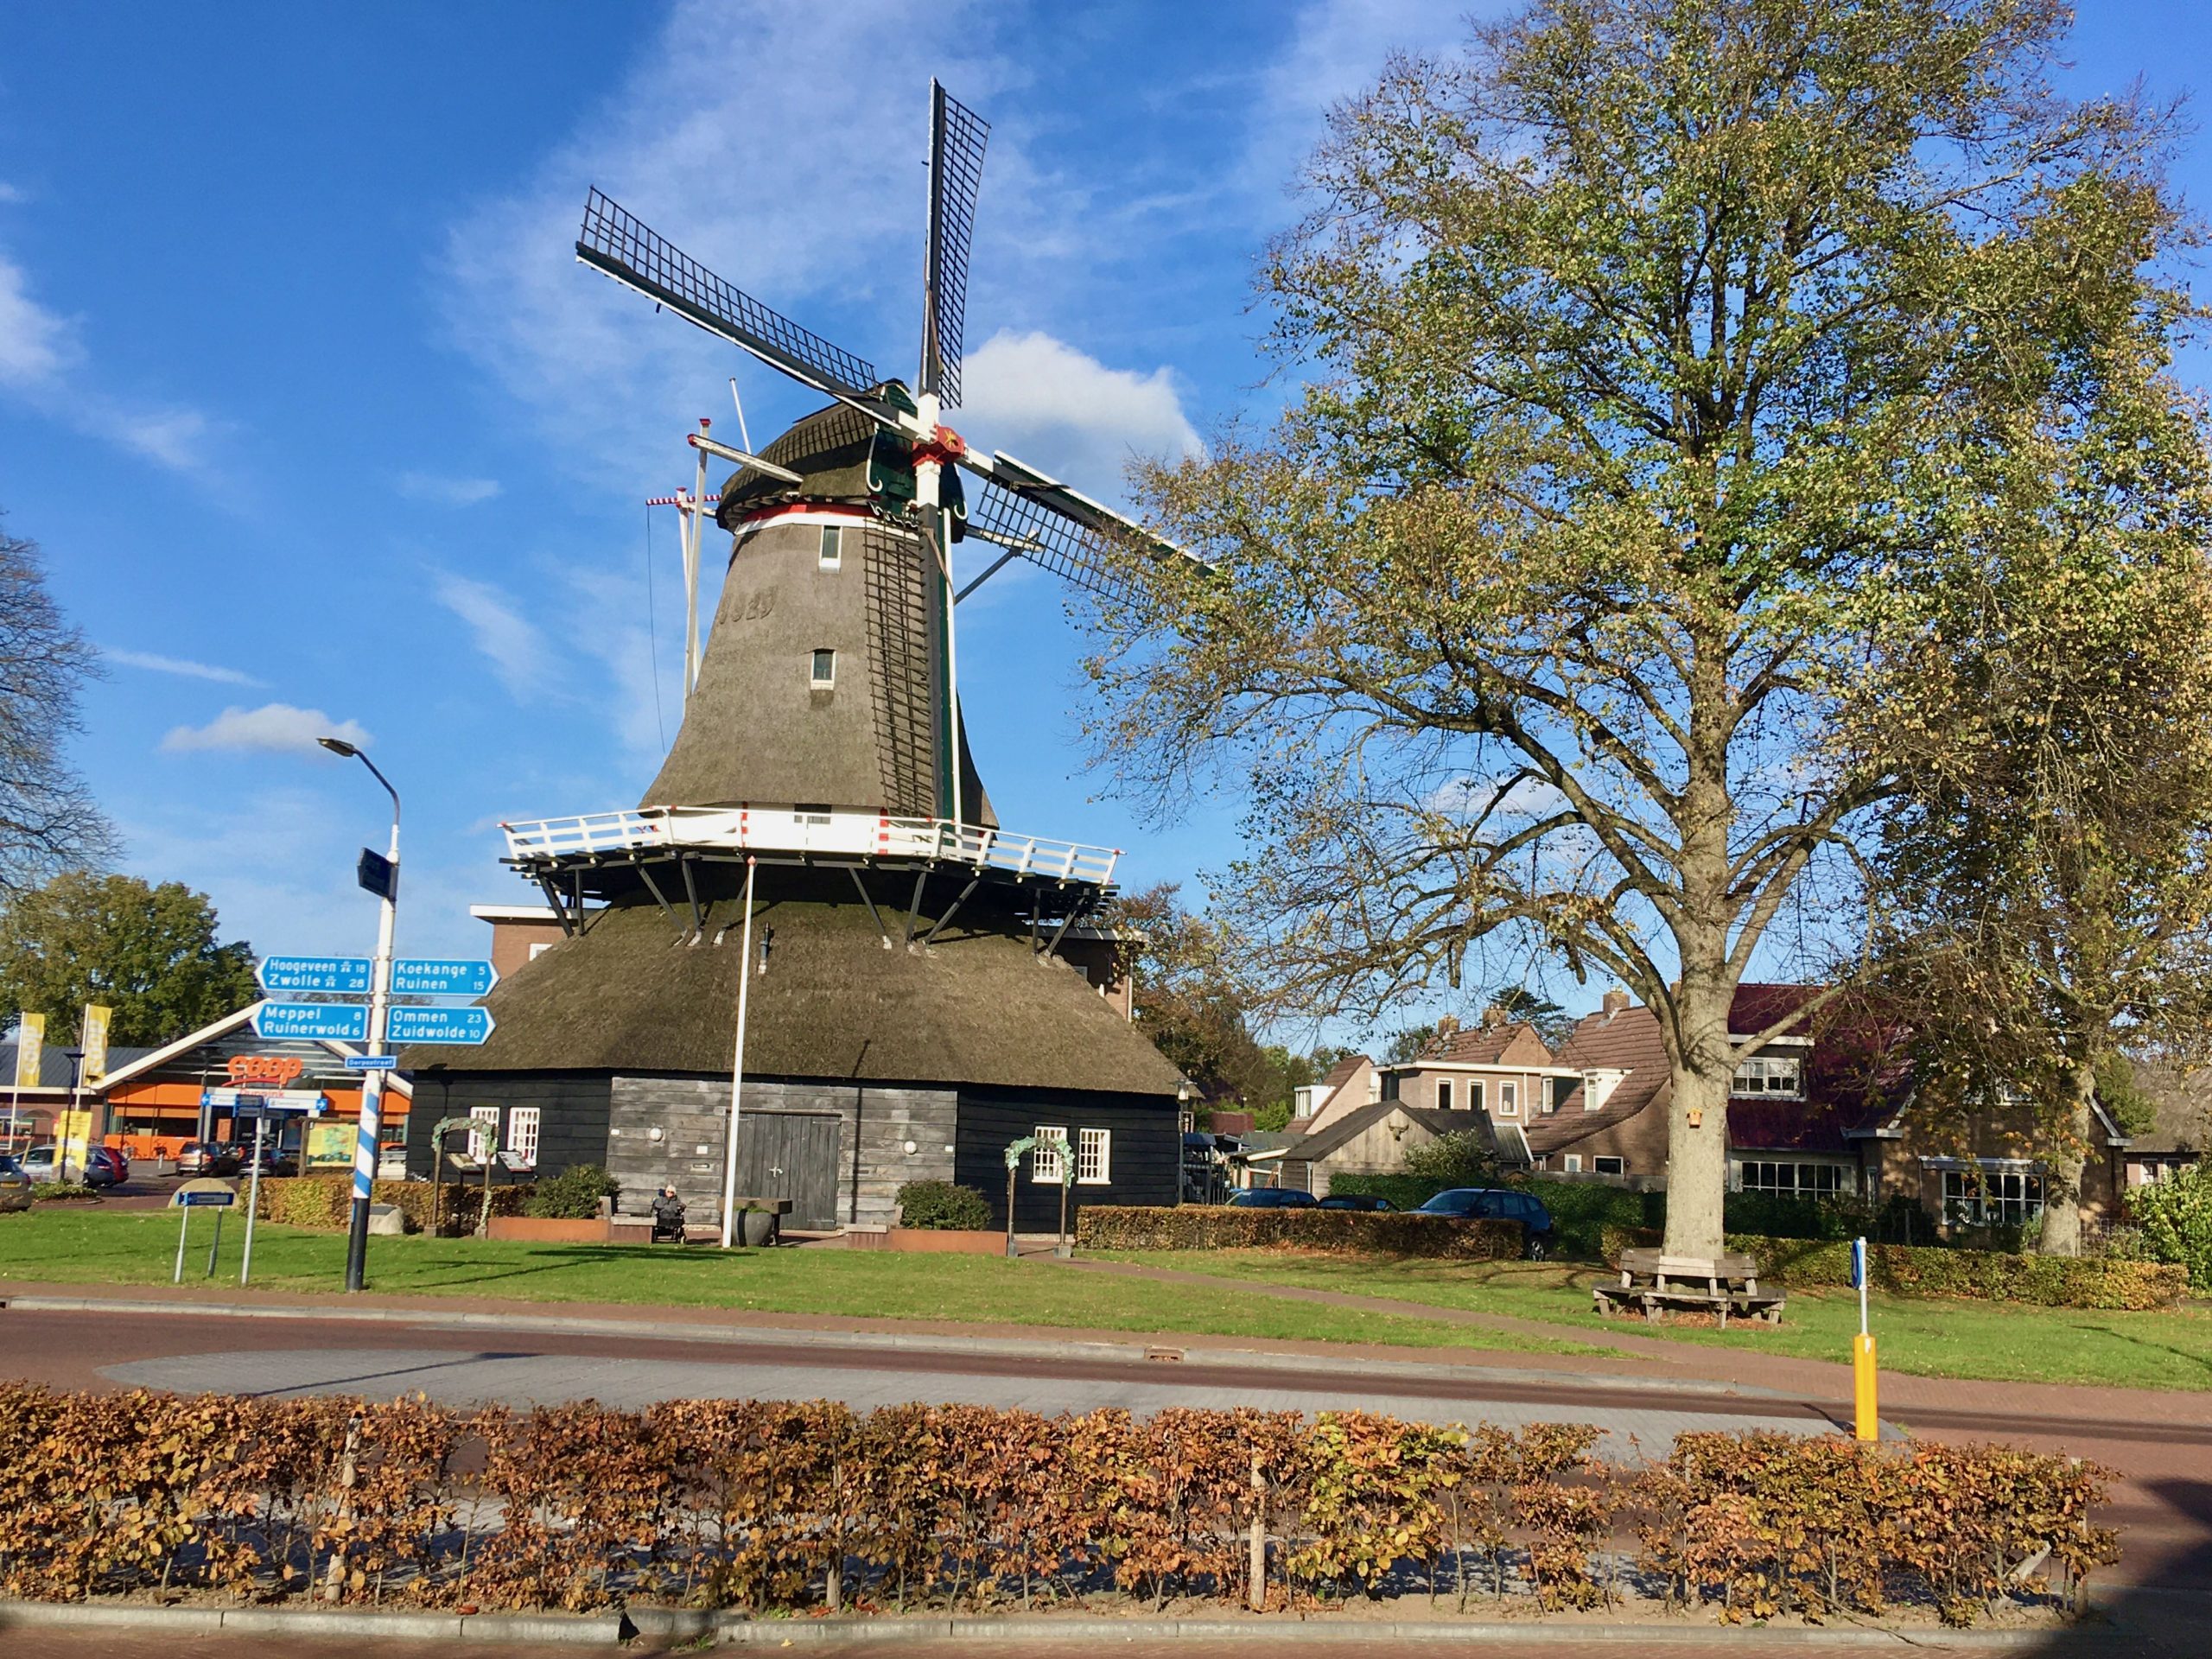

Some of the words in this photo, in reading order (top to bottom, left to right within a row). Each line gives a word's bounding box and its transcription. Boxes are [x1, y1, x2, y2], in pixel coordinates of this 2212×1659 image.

[270, 958, 337, 975] Hoogeveen
[355, 963, 367, 974] 18
[397, 962, 467, 979] Koekange
[478, 965, 486, 976] 5
[268, 973, 321, 987] Zwolle
[348, 978, 365, 988] 28
[396, 977, 448, 989] Ruinen
[473, 981, 485, 991] 15
[264, 1006, 322, 1021] Meppel
[353, 1011, 362, 1021] 8
[392, 1010, 448, 1023] Ommen
[467, 1014, 482, 1024] 23
[264, 1021, 350, 1036] Ruinerwold
[352, 1027, 360, 1036] 6
[391, 1025, 467, 1038] Zuidwolde
[469, 1029, 481, 1039] 10
[227, 1056, 302, 1086] coop
